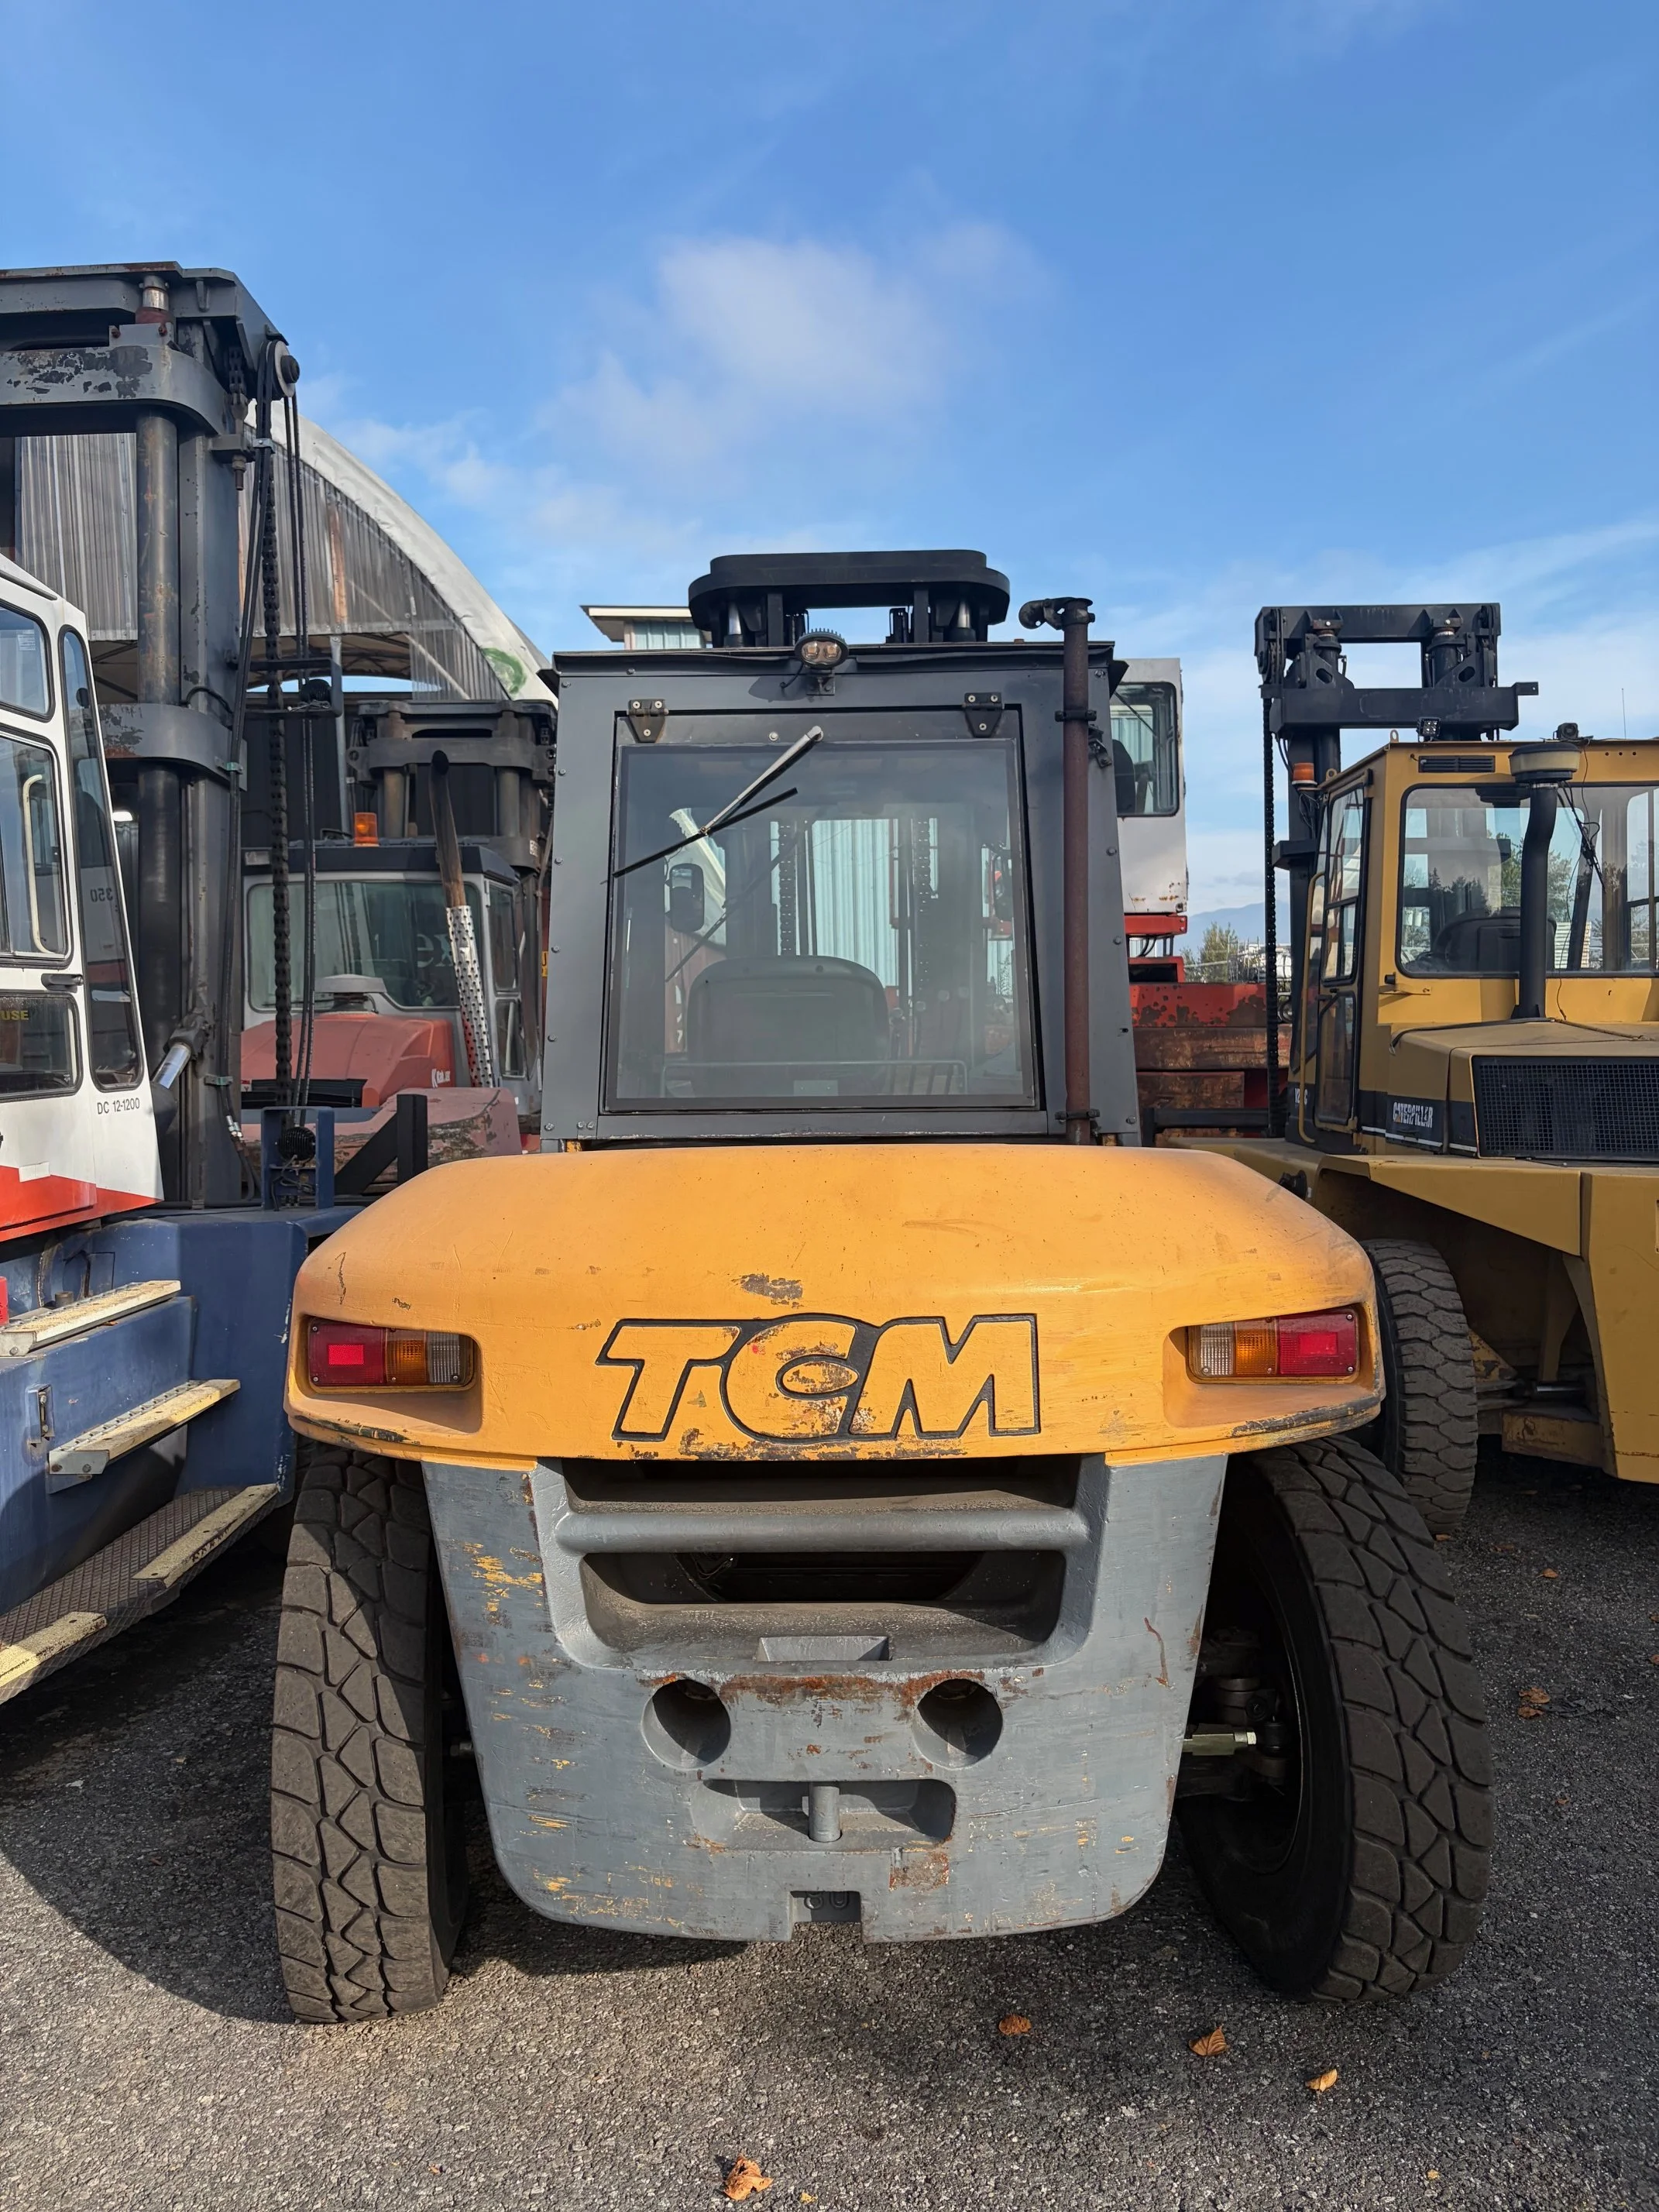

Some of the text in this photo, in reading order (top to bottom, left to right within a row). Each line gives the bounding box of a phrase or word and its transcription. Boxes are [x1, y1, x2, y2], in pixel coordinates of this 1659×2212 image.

[97, 1097, 139, 1115] DC 12-1200
[1393, 1101, 1434, 1128] CATERPILLAR
[596, 1312, 1042, 1445] TCM
